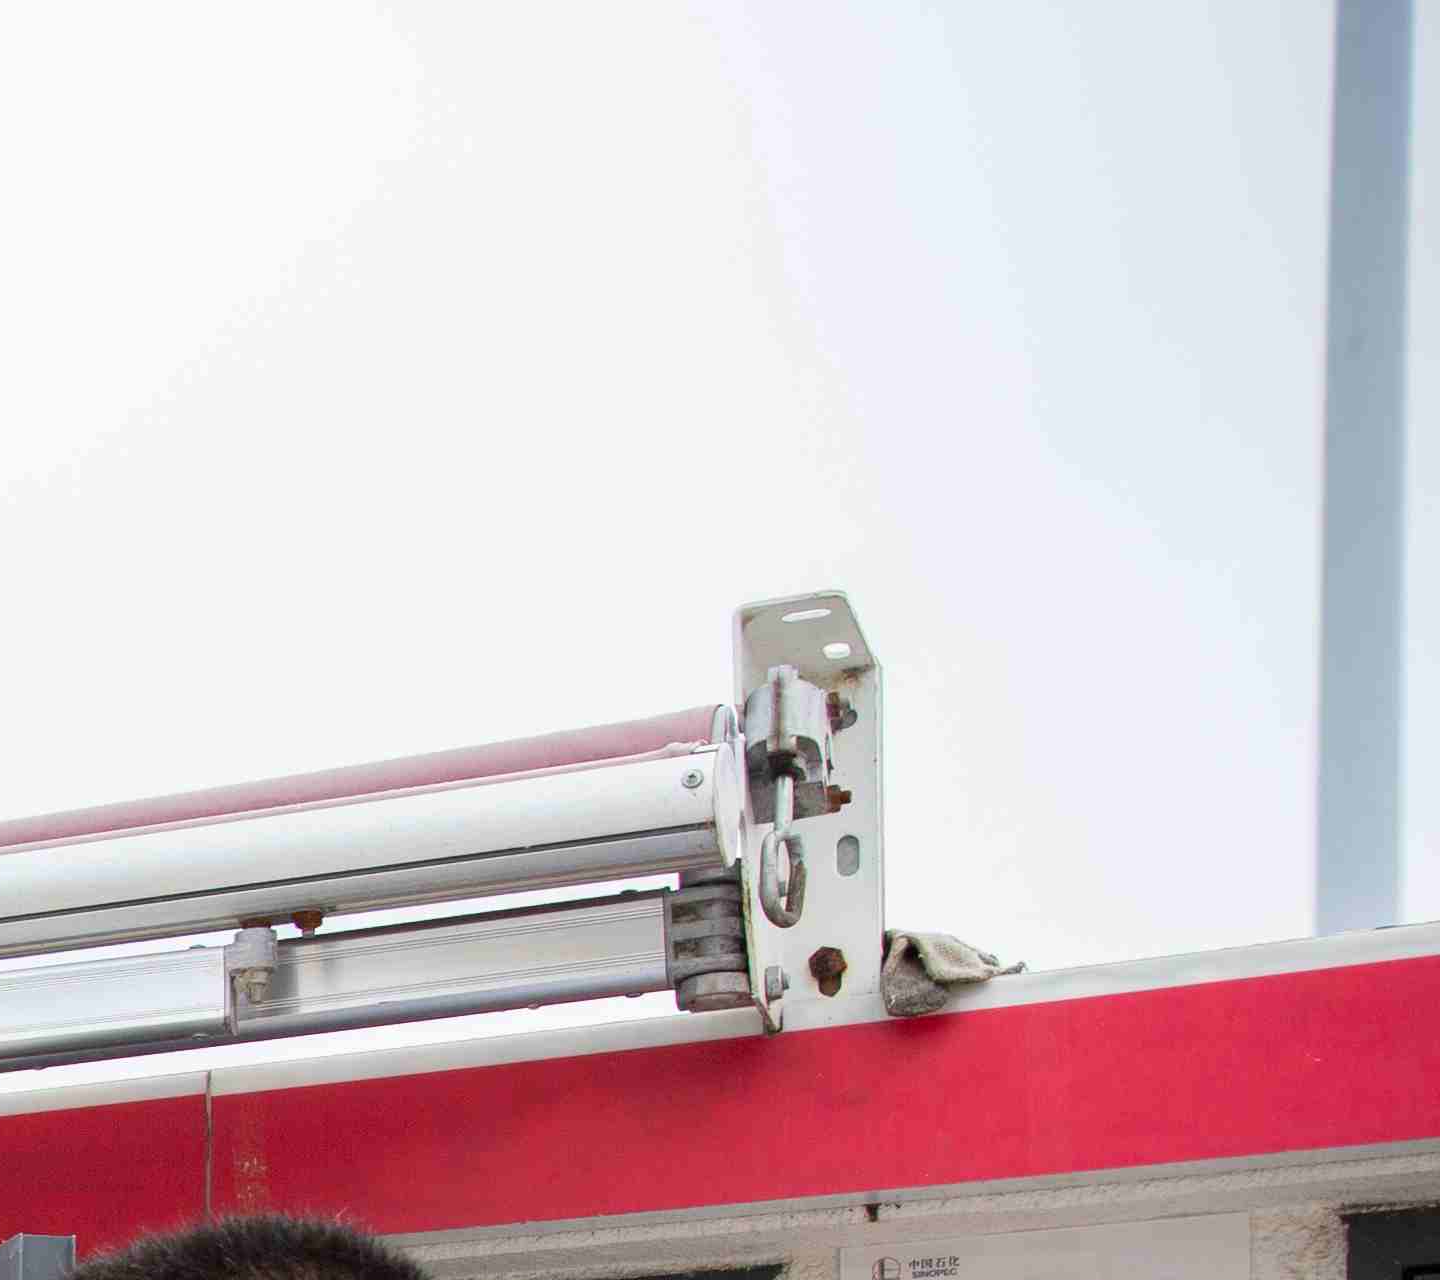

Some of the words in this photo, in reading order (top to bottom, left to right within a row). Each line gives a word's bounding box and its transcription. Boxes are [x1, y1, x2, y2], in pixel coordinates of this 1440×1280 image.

[908, 1255, 960, 1269] 中国石化
[911, 1268, 958, 1279] SINOPEC
